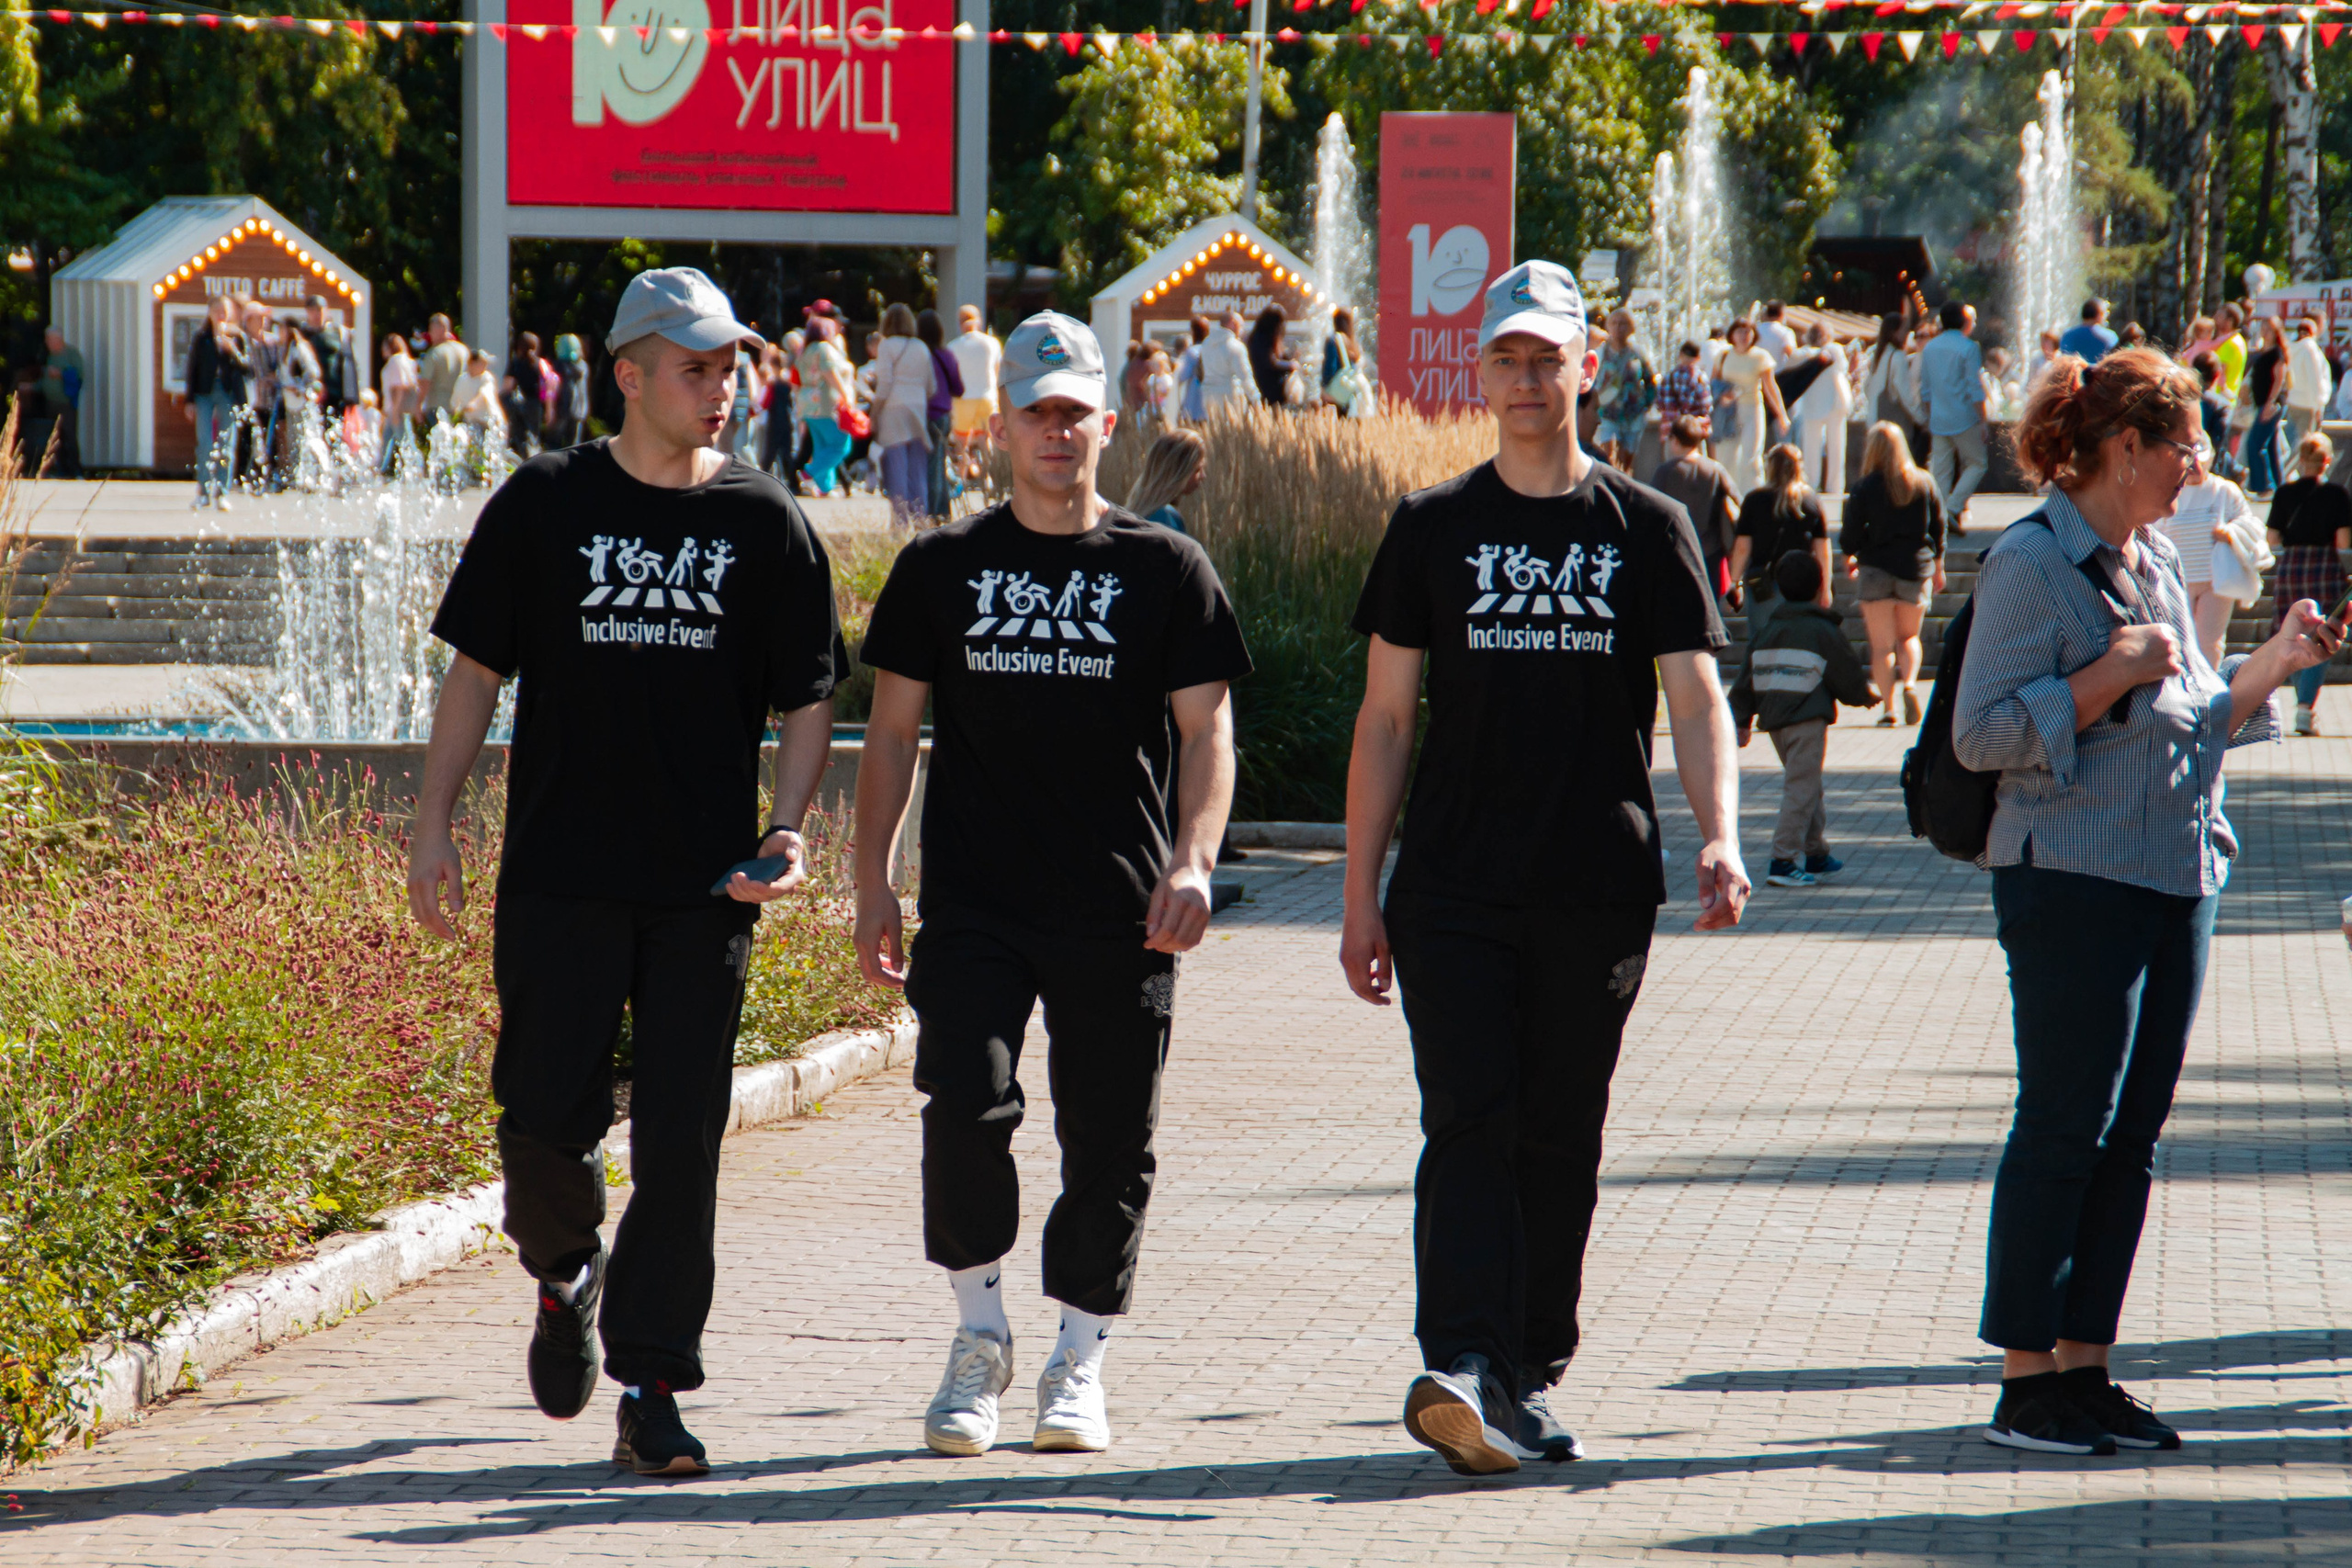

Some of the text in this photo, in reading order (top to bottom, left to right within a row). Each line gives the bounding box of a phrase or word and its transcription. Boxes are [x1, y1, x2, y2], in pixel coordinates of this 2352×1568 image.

[726, 55, 899, 143] УЛИЦ
[202, 275, 254, 297] TUTTO
[1204, 270, 1262, 291] ЧУРРОС
[1406, 222, 1490, 318] 10
[1408, 367, 1486, 407] УЛИЦ
[581, 613, 717, 649] Inclusive Event
[1467, 620, 1614, 655] Inclusive Event
[965, 643, 1114, 680] Inclusive Event
